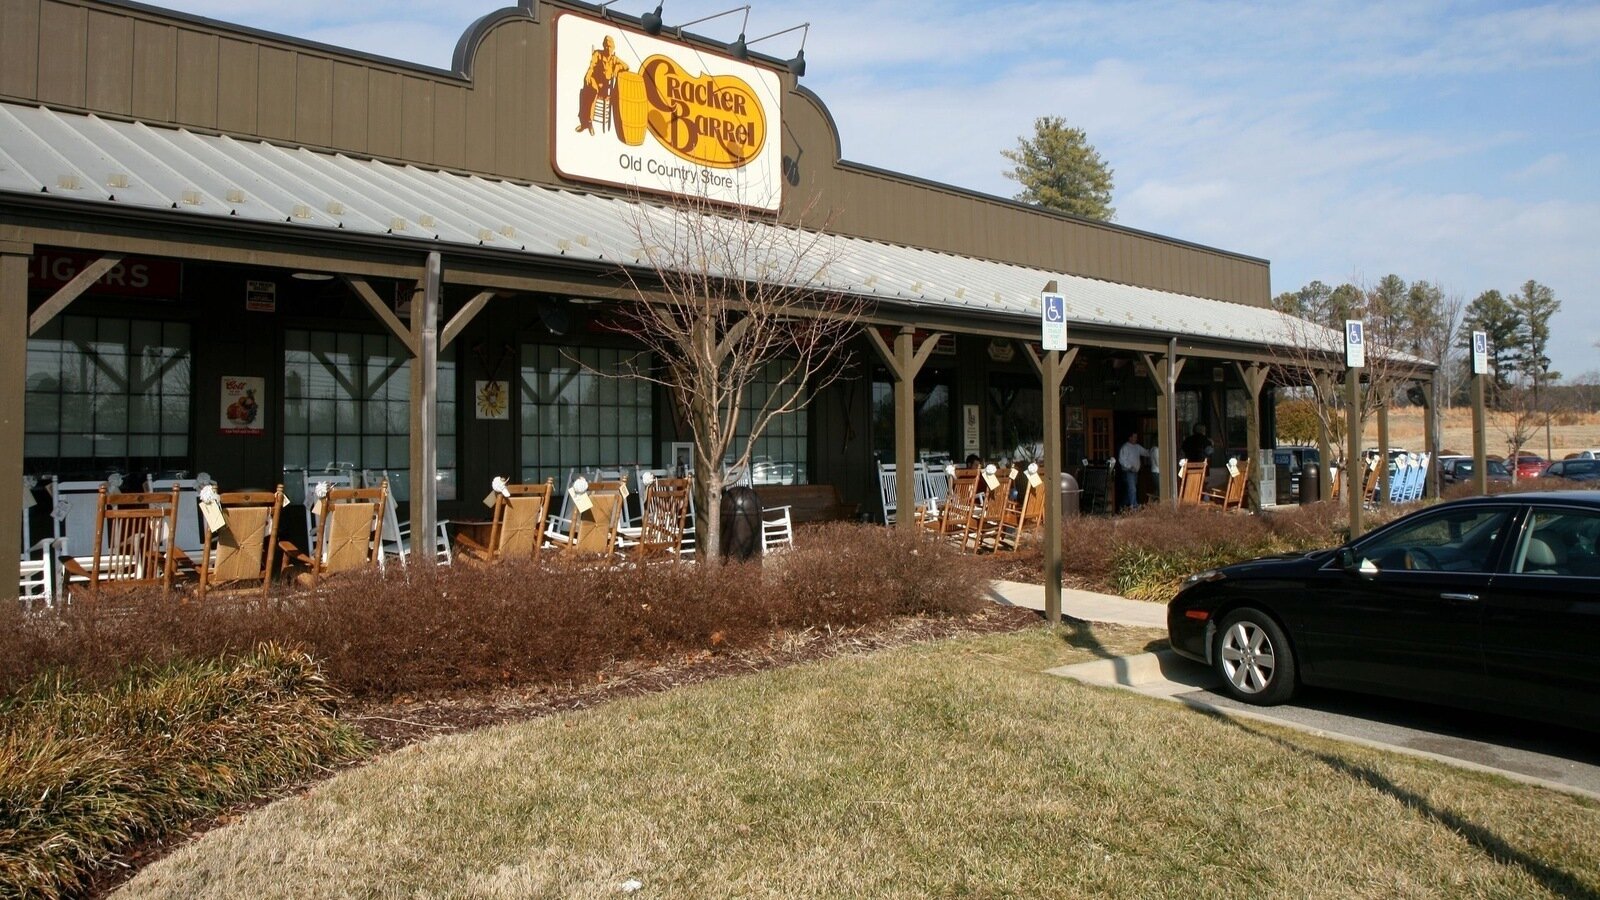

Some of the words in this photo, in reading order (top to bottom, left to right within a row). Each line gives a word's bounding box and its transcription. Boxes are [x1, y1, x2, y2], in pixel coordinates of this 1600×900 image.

[642, 59, 746, 116] Cracker
[670, 98, 755, 154] Barrel
[619, 153, 642, 172] Old
[647, 158, 698, 184] Country
[701, 169, 733, 189] Store
[28, 254, 150, 288] IGRS
